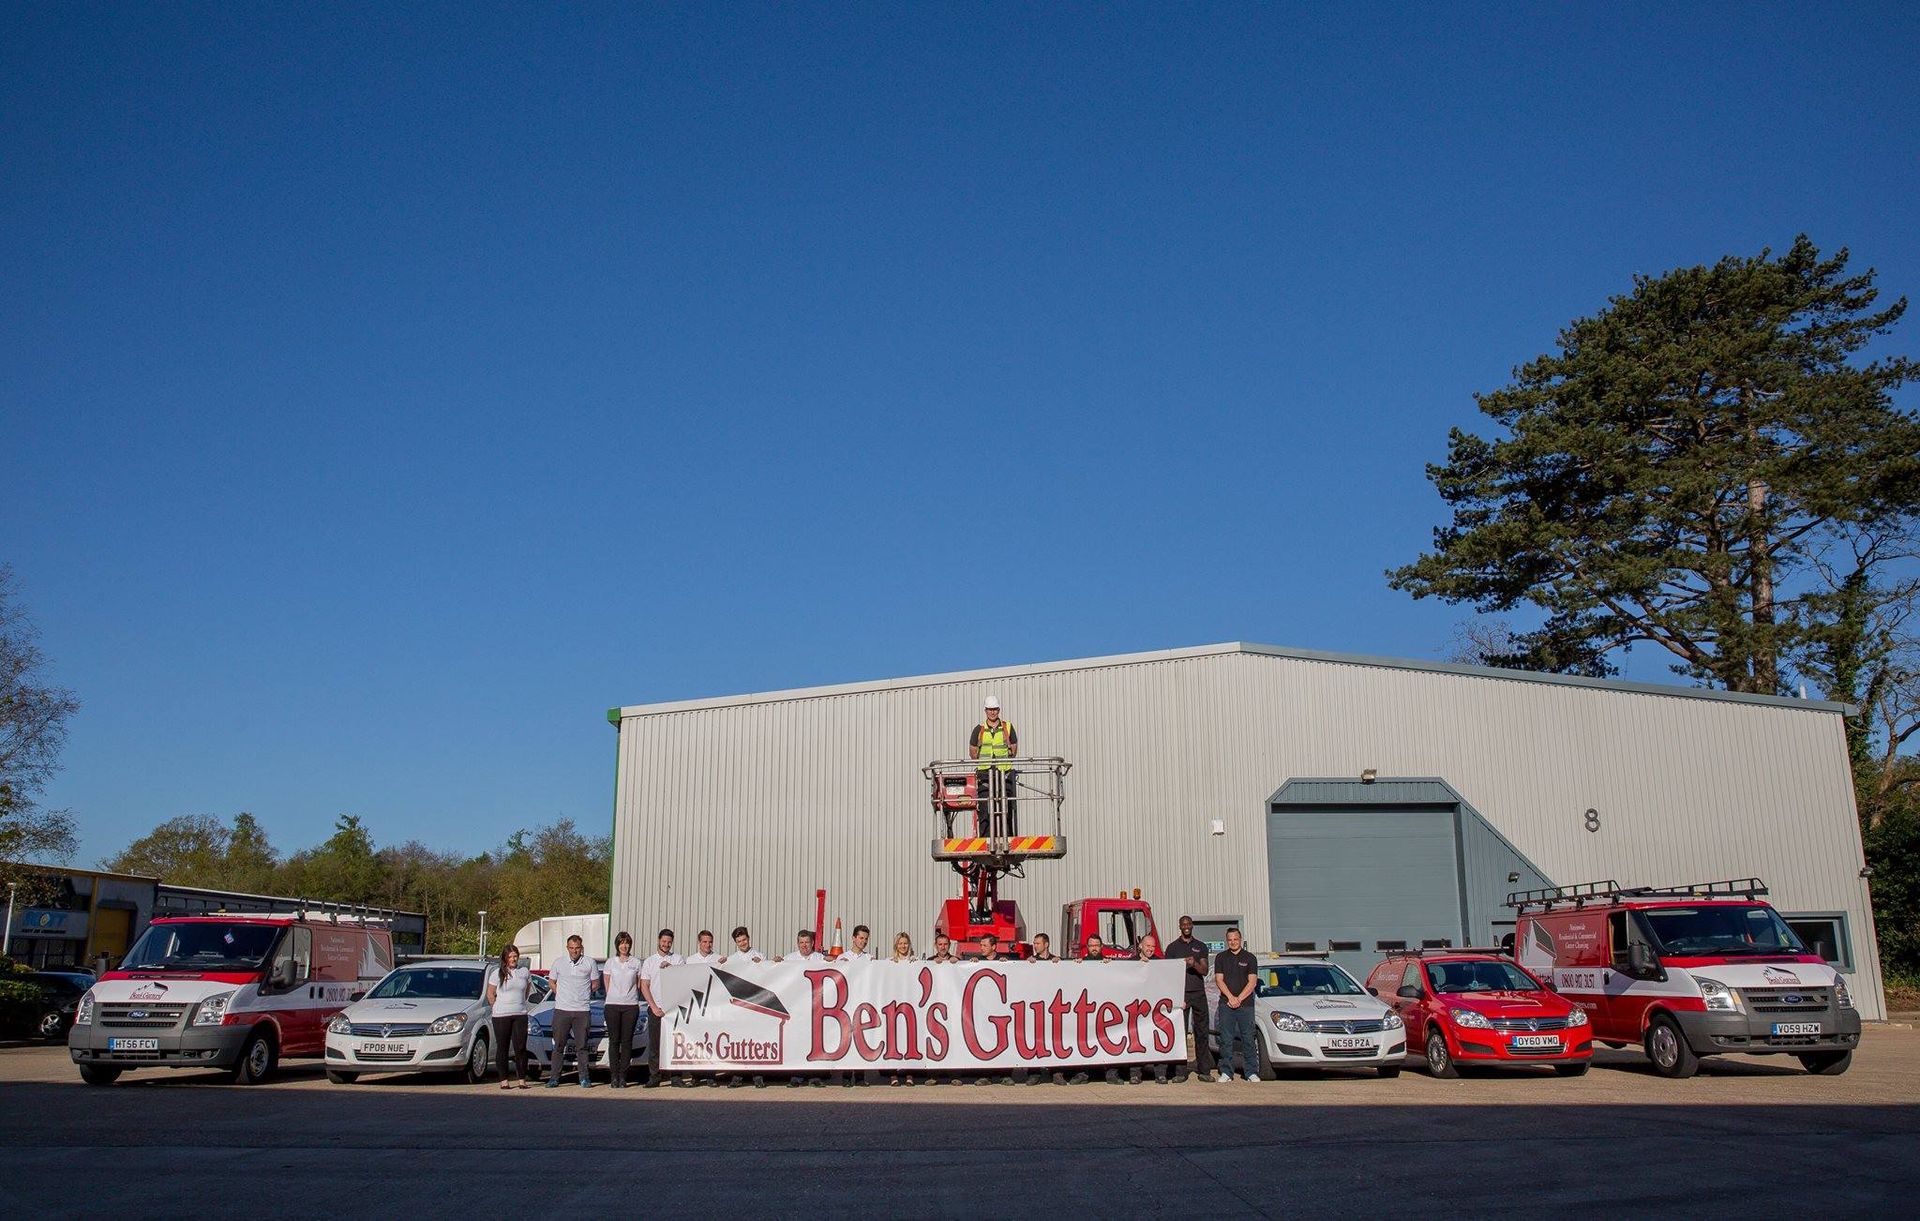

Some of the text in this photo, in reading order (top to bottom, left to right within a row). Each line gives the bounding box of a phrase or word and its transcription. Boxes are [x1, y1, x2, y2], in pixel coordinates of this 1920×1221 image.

[1585, 808, 1600, 832] 8
[803, 966, 1176, 1063] Ben's Gutters
[1779, 1024, 1801, 1034] VO59
[115, 1040, 156, 1049] HT56 FCV
[672, 1031, 778, 1060] Ben's Gutters
[1331, 1038, 1370, 1048] NC58 PZA
[1518, 1036, 1540, 1046] OY60
[363, 1043, 405, 1052] FP08 NUE
